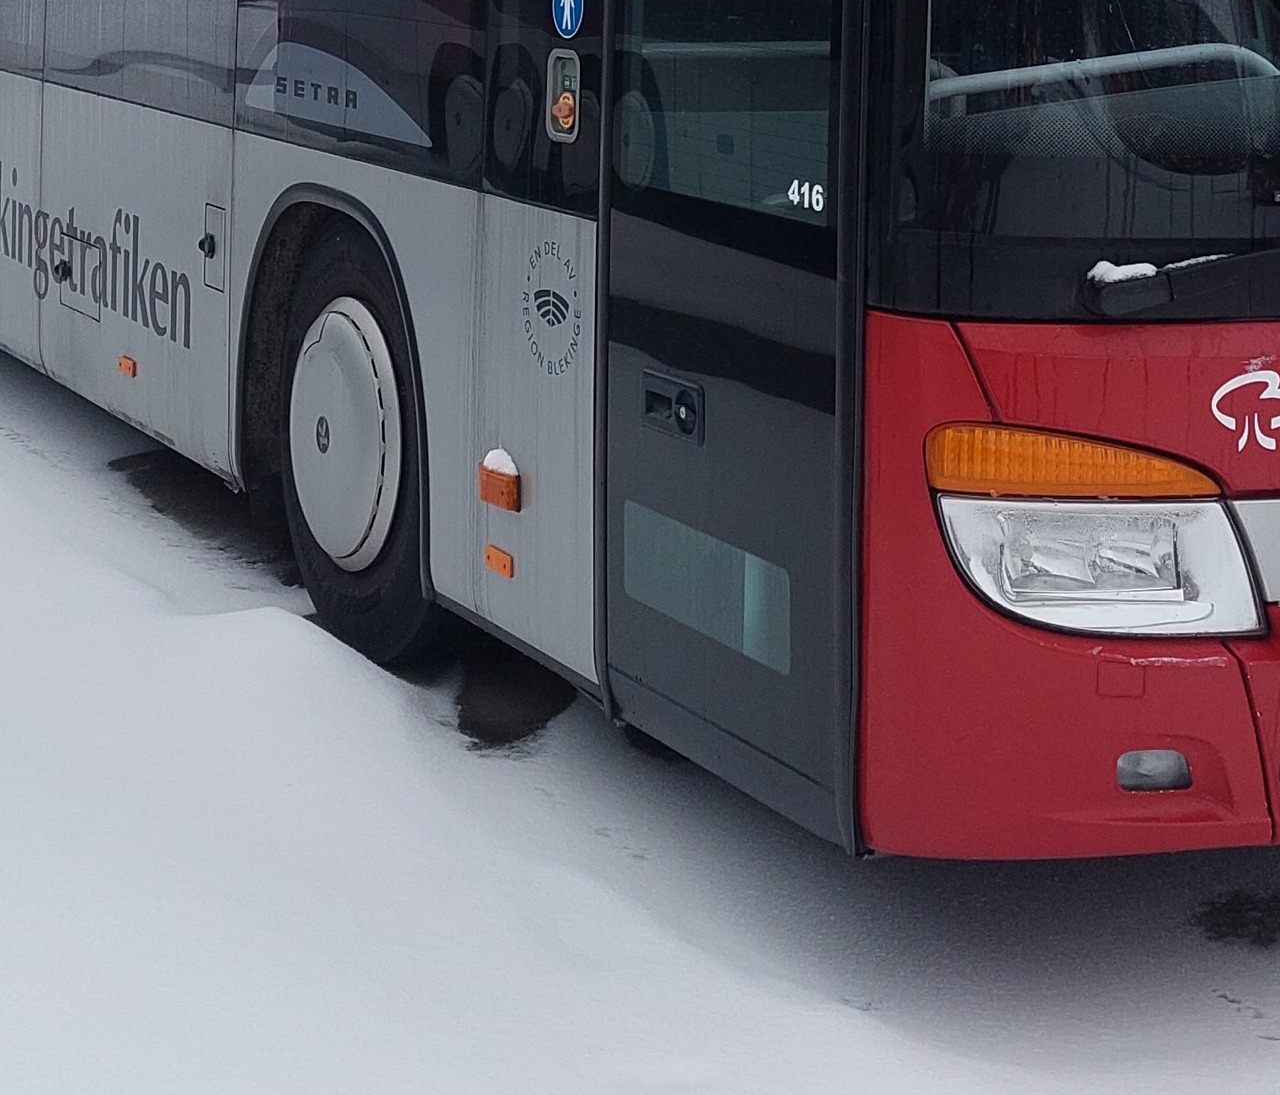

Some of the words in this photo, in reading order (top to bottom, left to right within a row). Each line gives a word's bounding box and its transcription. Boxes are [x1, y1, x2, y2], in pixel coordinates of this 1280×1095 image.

[276, 76, 358, 110] SETRA
[787, 179, 824, 211] 416
[529, 246, 542, 270] EN
[544, 241, 562, 261] DEL
[563, 258, 577, 281] AV
[522, 291, 545, 368] REGION
[547, 309, 582, 376] BLEKINGE
